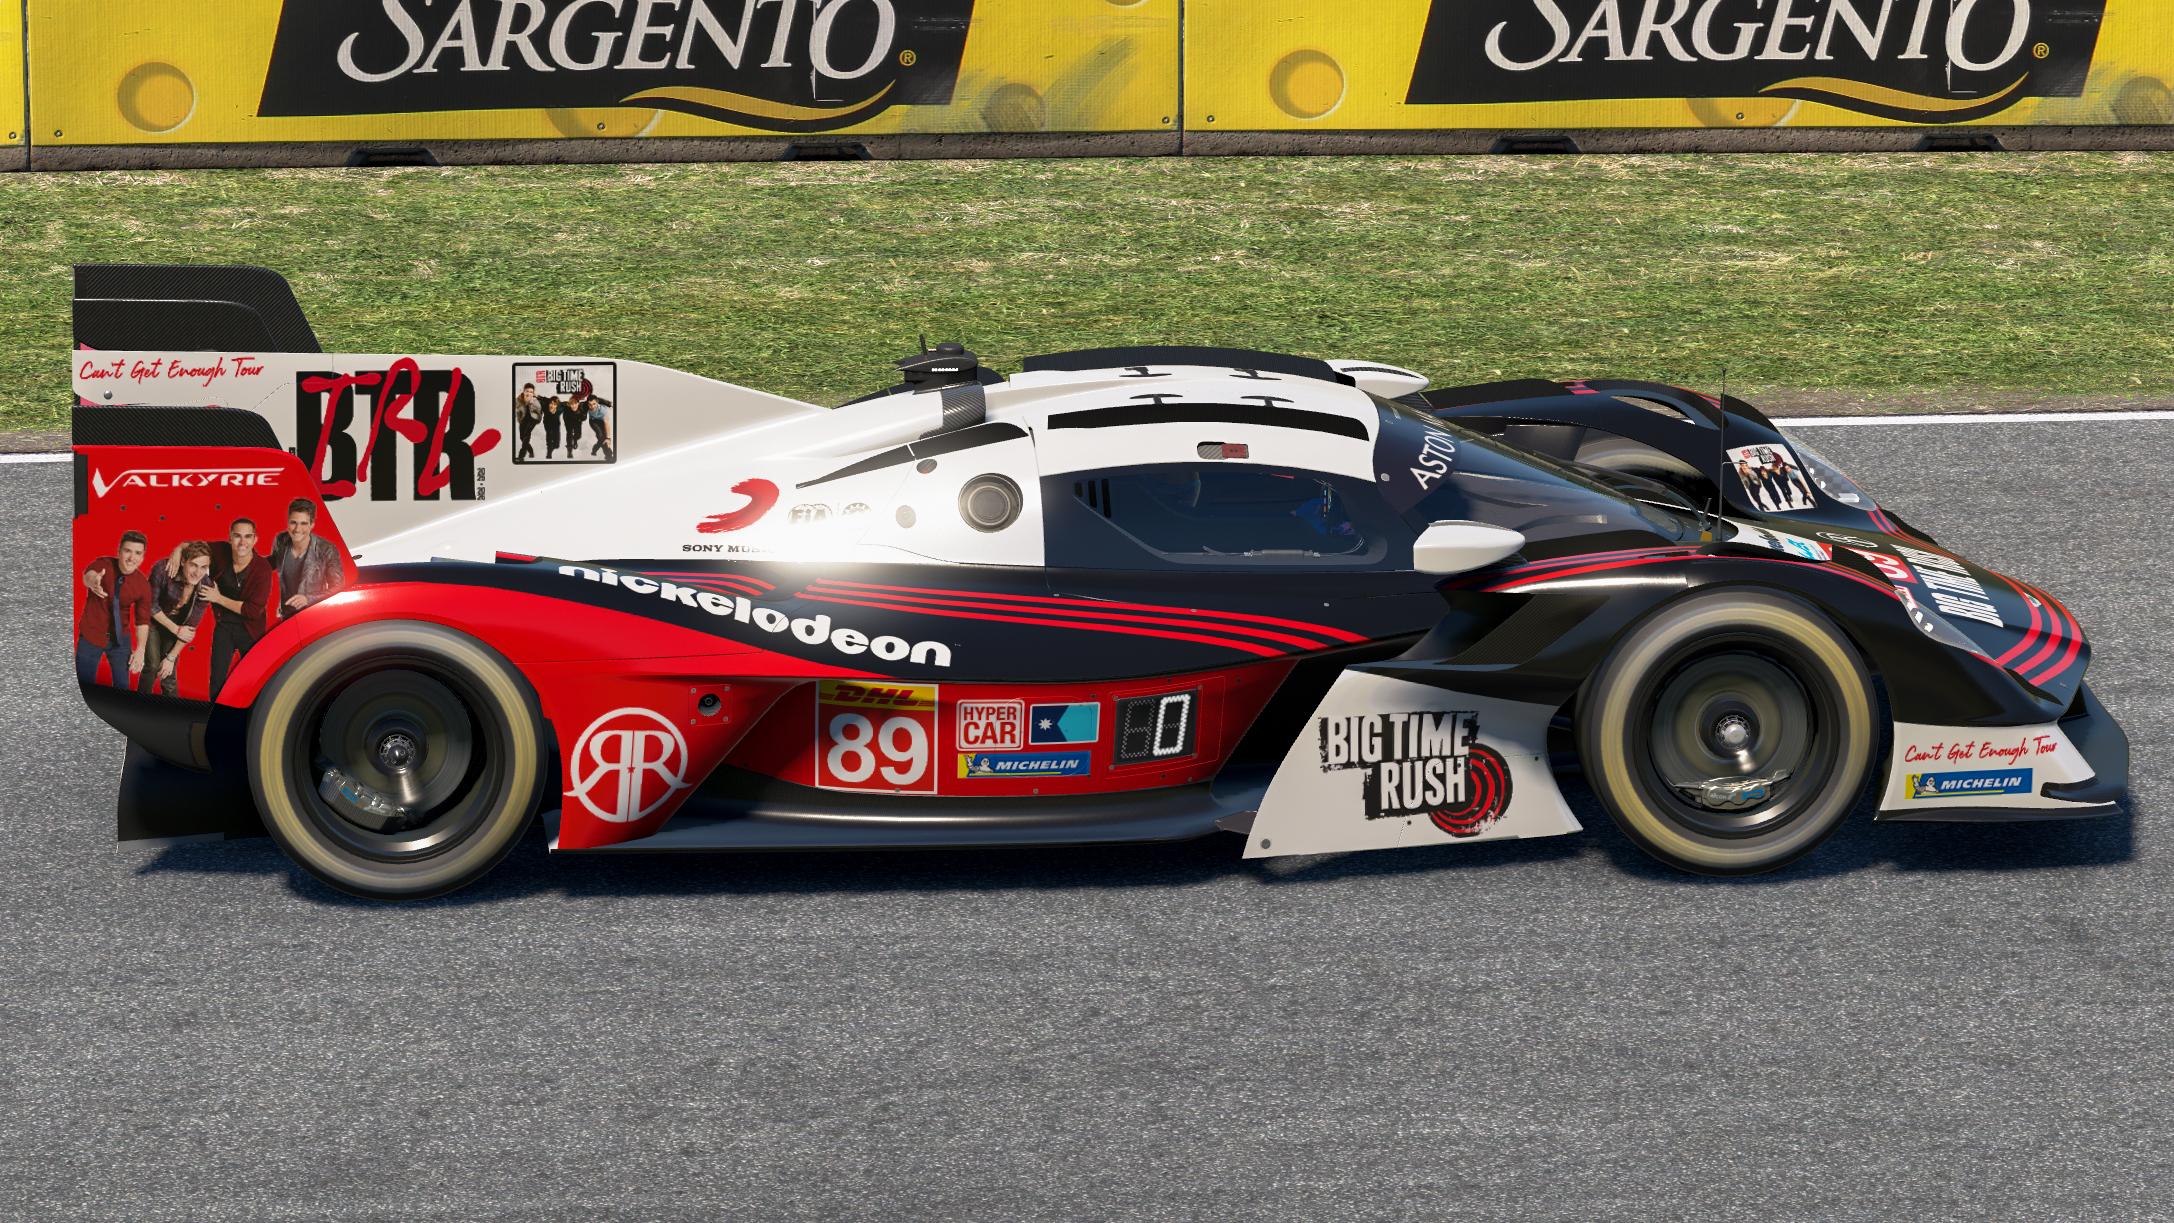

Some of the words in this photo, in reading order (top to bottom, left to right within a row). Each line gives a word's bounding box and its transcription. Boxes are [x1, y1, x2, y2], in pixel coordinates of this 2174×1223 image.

[337, 0, 897, 83] SARGENTO
[1484, 0, 2029, 72] SARGENTO
[79, 359, 125, 380] Can't
[130, 358, 162, 384] Get
[167, 357, 226, 387] Enough
[231, 357, 265, 377] Tour
[1410, 424, 1456, 490] ASTON
[92, 467, 285, 499] VALKYRIE
[682, 544, 723, 552] SONY
[558, 564, 952, 667] nickelodeon
[834, 684, 920, 706] DHL
[963, 706, 1017, 721] HYPER
[963, 721, 1017, 745] CAR
[1327, 715, 1383, 765] BIG
[1389, 713, 1469, 760] TIME
[827, 712, 929, 786] 89
[995, 759, 1080, 770] MICHELIN
[1904, 742, 1944, 764] Can't
[1948, 740, 1975, 765] Get
[1978, 737, 2029, 766] Enough
[2033, 735, 2058, 756] Tour
[1380, 756, 1466, 810] RUSH
[1940, 776, 2023, 790] MICHELIN
